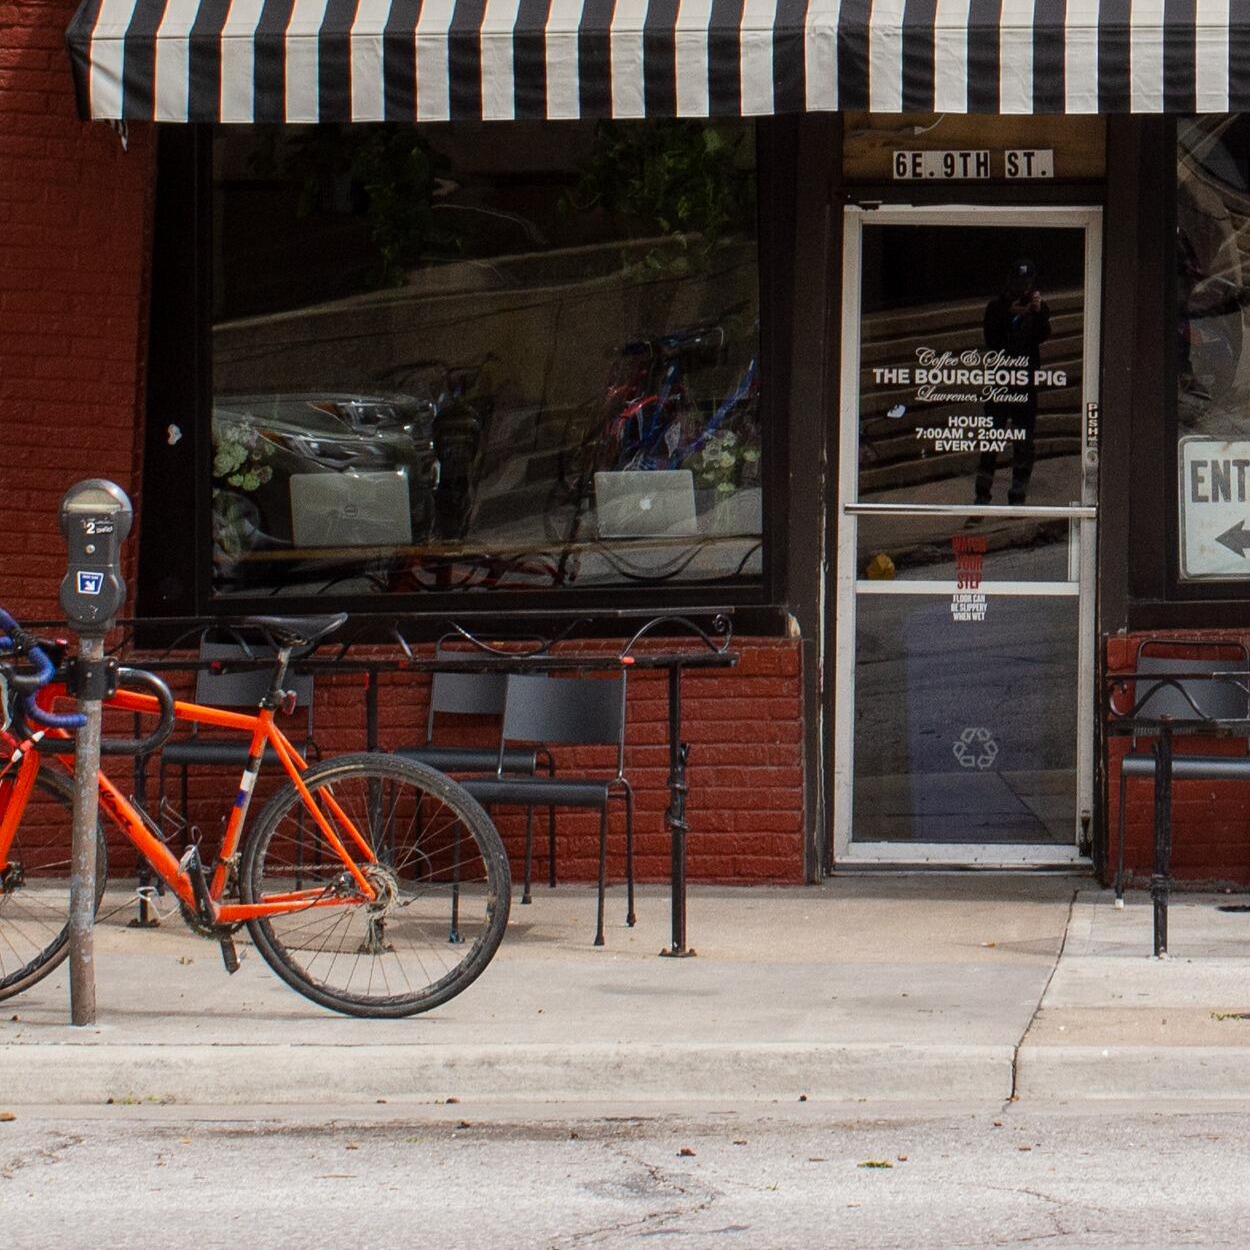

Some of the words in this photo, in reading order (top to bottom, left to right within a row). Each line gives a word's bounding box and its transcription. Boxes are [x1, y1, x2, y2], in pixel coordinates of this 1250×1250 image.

[1007, 152, 1048, 177] ST.
[916, 347, 958, 371] Coffee
[983, 349, 1029, 371] Spirits
[873, 369, 910, 384] THE
[915, 369, 1029, 386] BOURGEOIS
[1034, 370, 1067, 386] PIG
[980, 386, 1029, 403] Kansas
[948, 416, 994, 427] HOURS
[1088, 403, 1098, 435] PUSH
[915, 427, 964, 439] 7:00AM
[977, 429, 1026, 440] 2:00AM
[935, 440, 977, 452] EVERY
[980, 440, 1007, 452] DAY
[973, 594, 985, 602] CAN
[959, 603, 988, 612] SLIPPERY
[972, 612, 985, 621] WET
